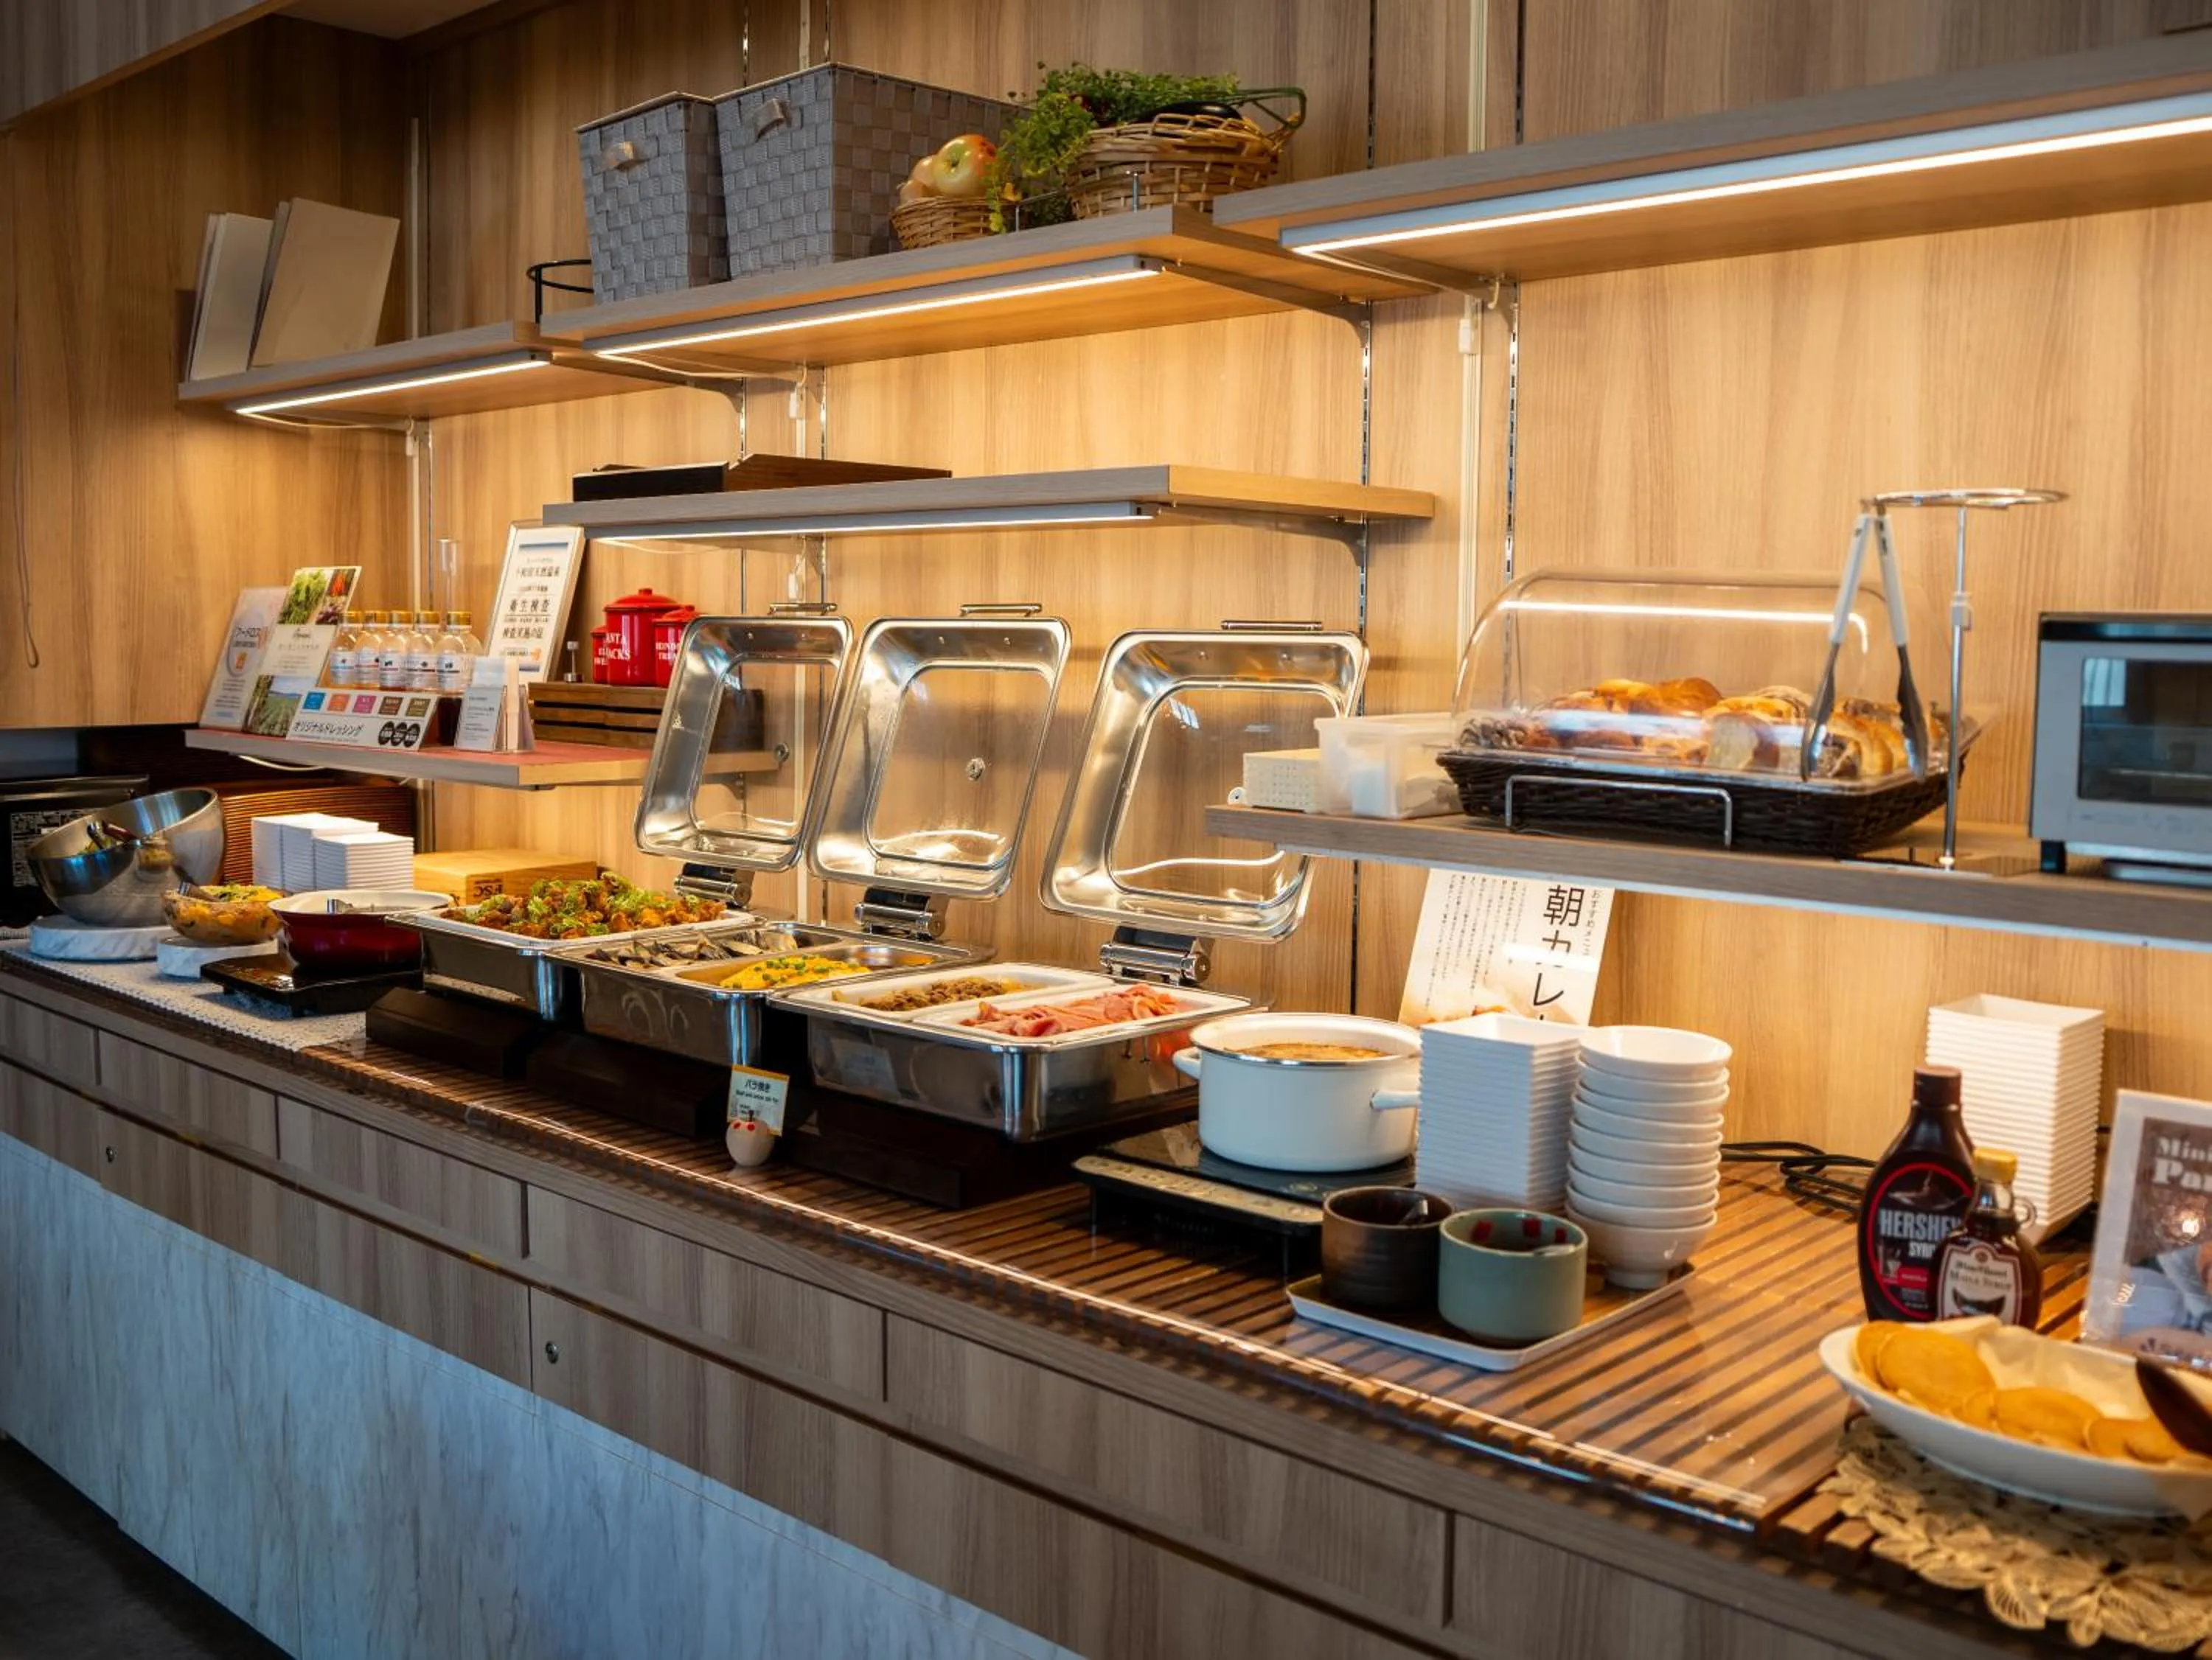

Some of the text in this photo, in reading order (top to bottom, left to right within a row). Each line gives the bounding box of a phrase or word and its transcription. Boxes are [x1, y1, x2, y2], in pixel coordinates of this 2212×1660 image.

[293, 720, 365, 737] オリジナルドレッシング
[1533, 885, 1585, 1021] 朝カレ
[1582, 890, 1601, 956] おすすめメニュ
